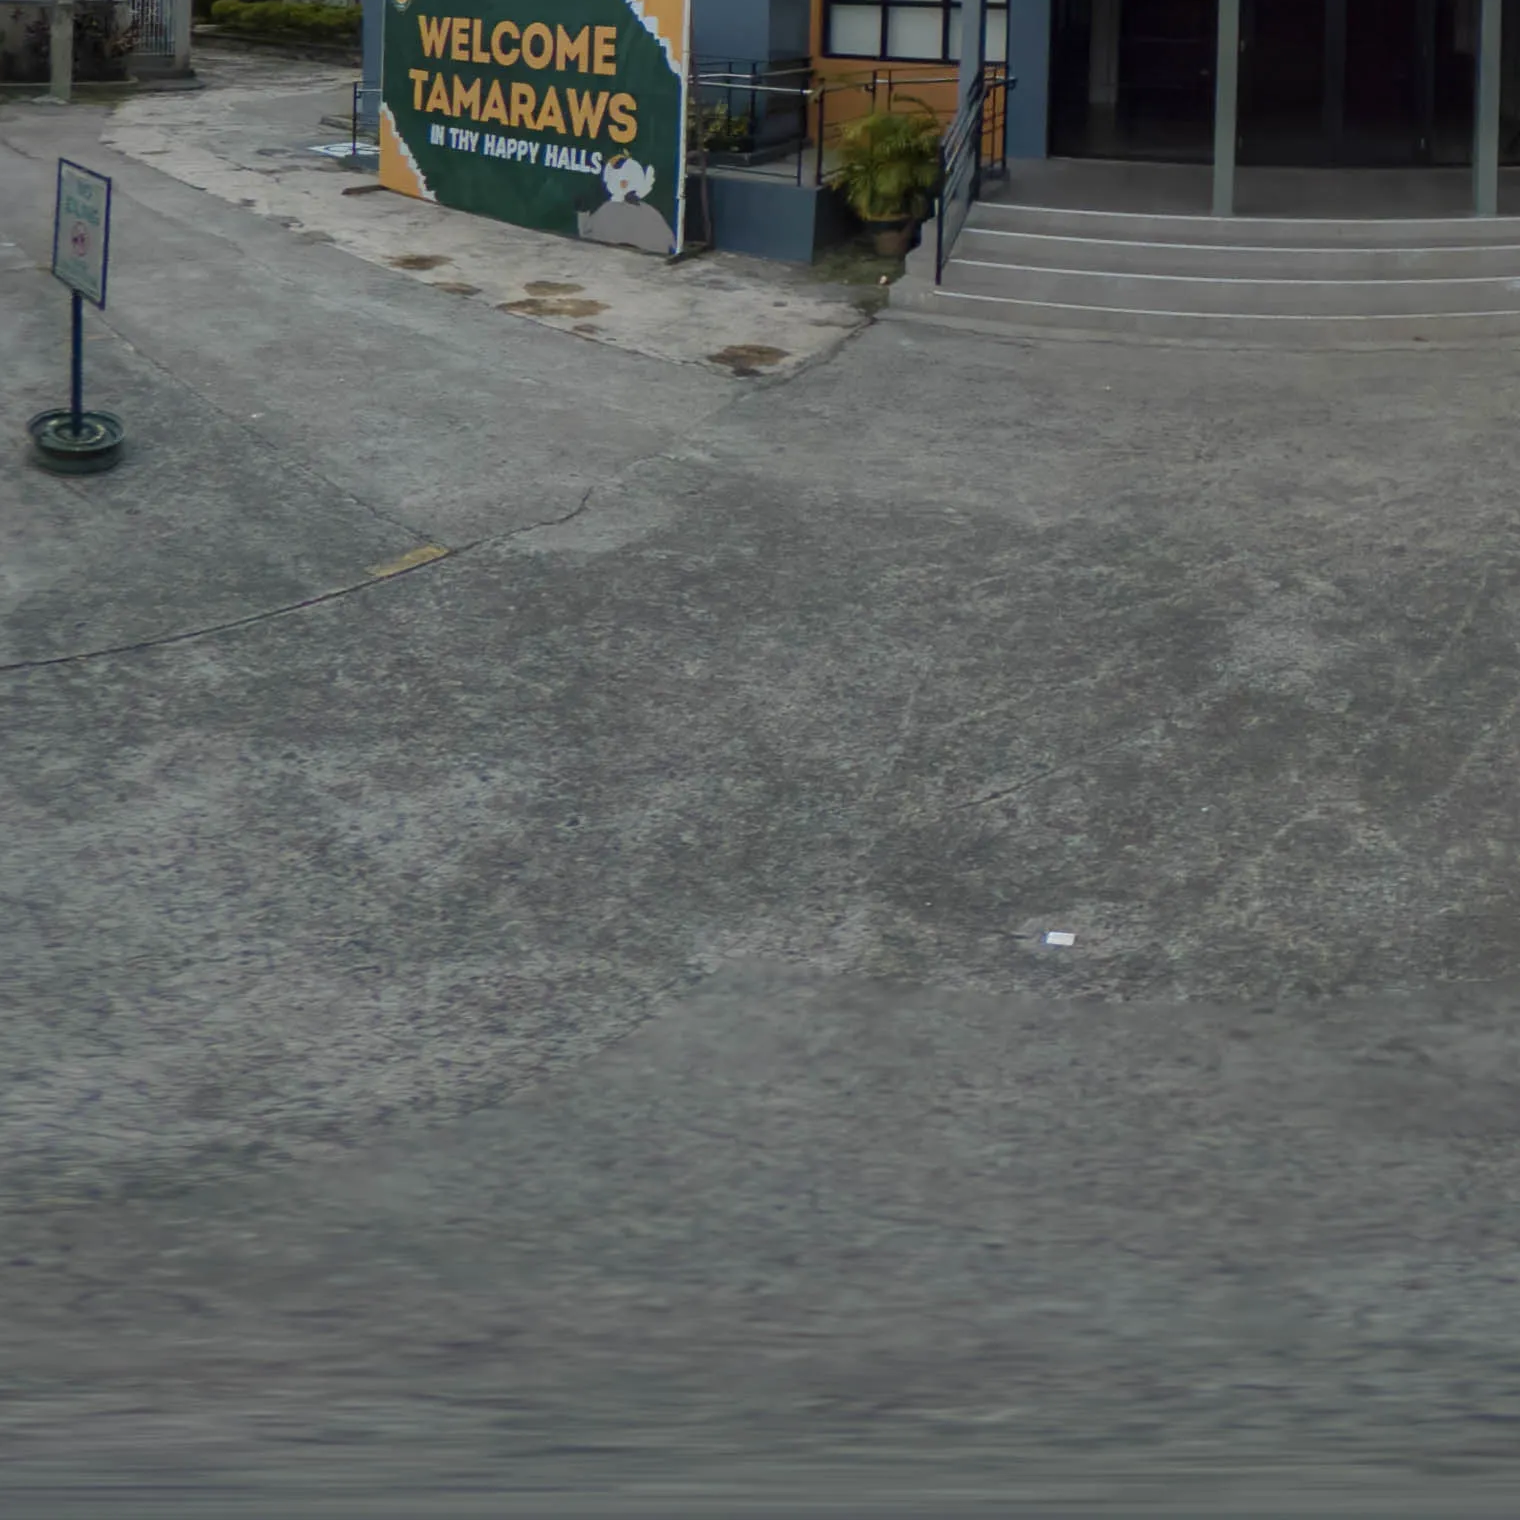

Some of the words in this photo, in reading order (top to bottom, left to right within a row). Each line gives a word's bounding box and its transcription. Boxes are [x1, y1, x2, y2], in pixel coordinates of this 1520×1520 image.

[417, 14, 617, 76] WELCOME
[408, 68, 638, 144] TAMARAWS
[429, 123, 445, 146] IN
[448, 127, 479, 153] THY
[483, 133, 540, 164] HAPPY
[544, 143, 603, 175] HALLS
